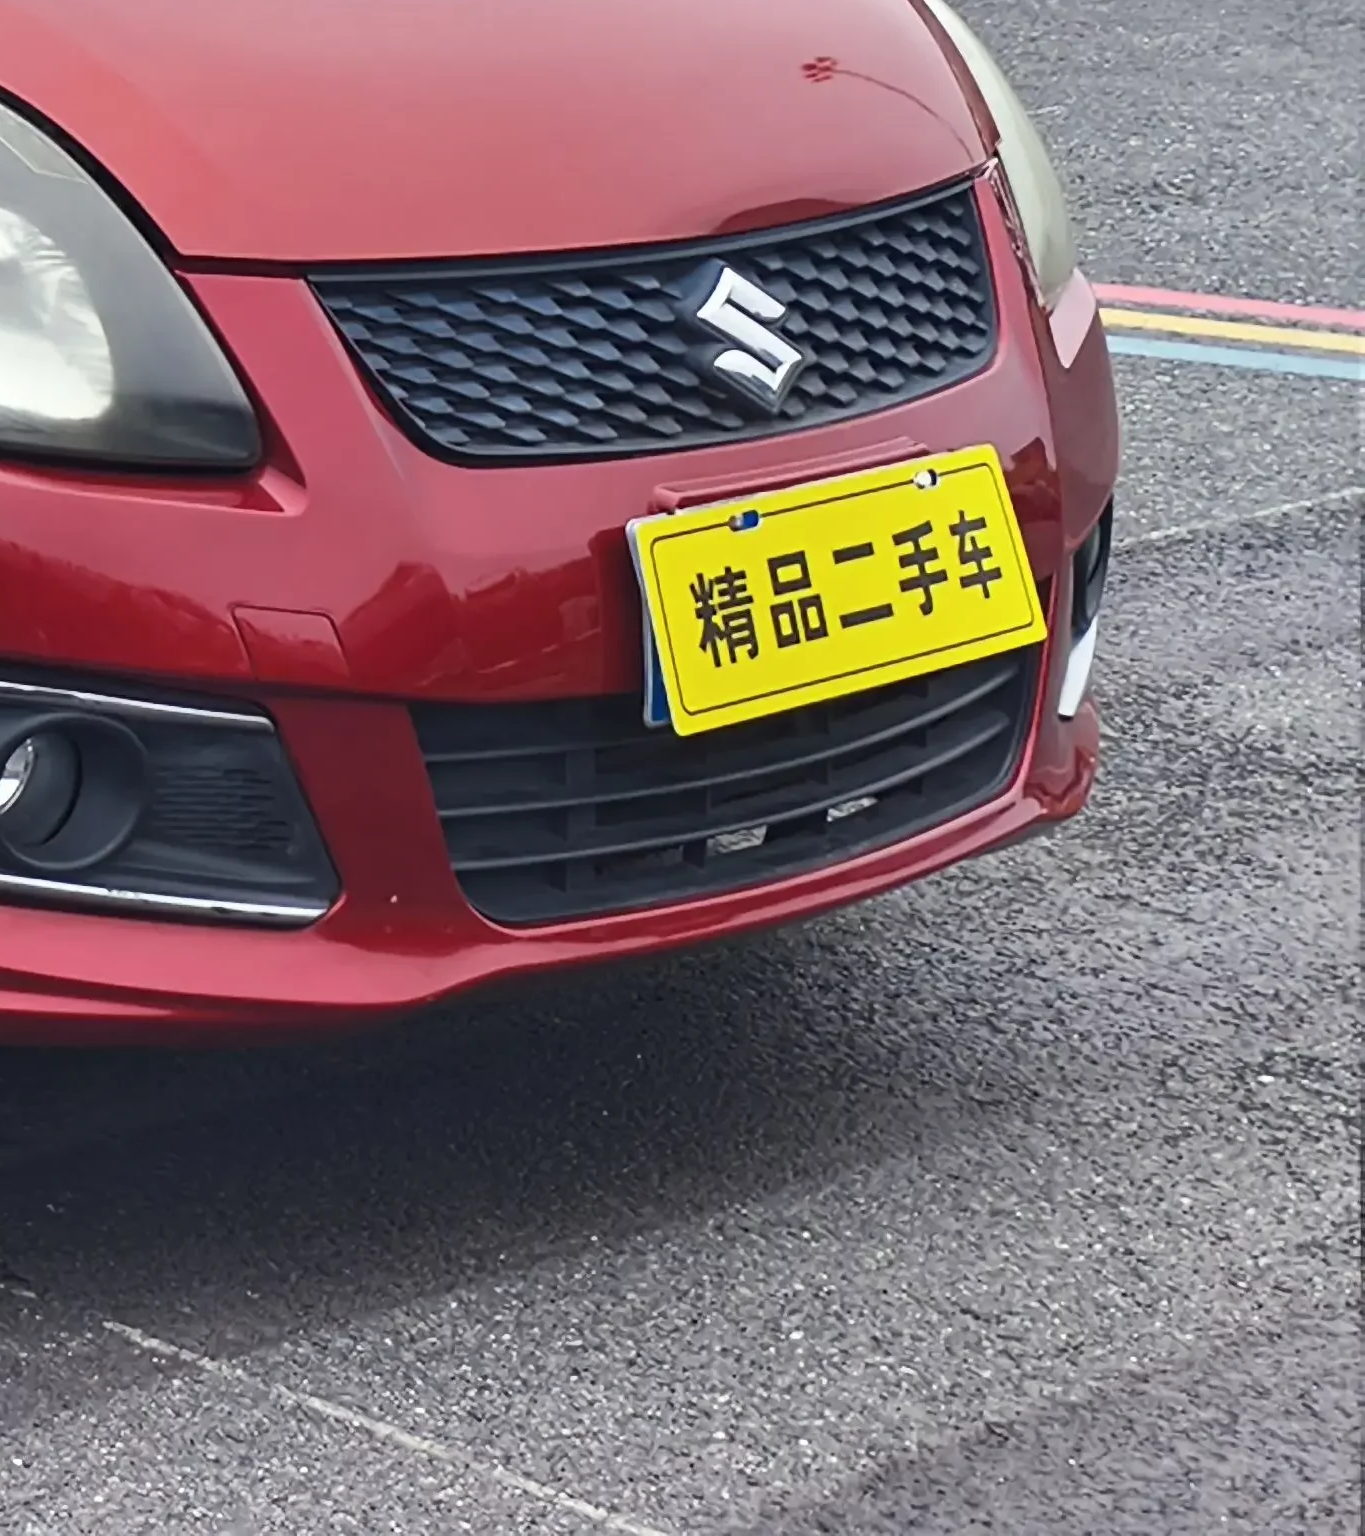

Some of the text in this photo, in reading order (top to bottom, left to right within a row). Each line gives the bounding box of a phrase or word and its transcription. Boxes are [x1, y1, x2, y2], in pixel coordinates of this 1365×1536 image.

[689, 509, 1002, 669] 精品二手车
